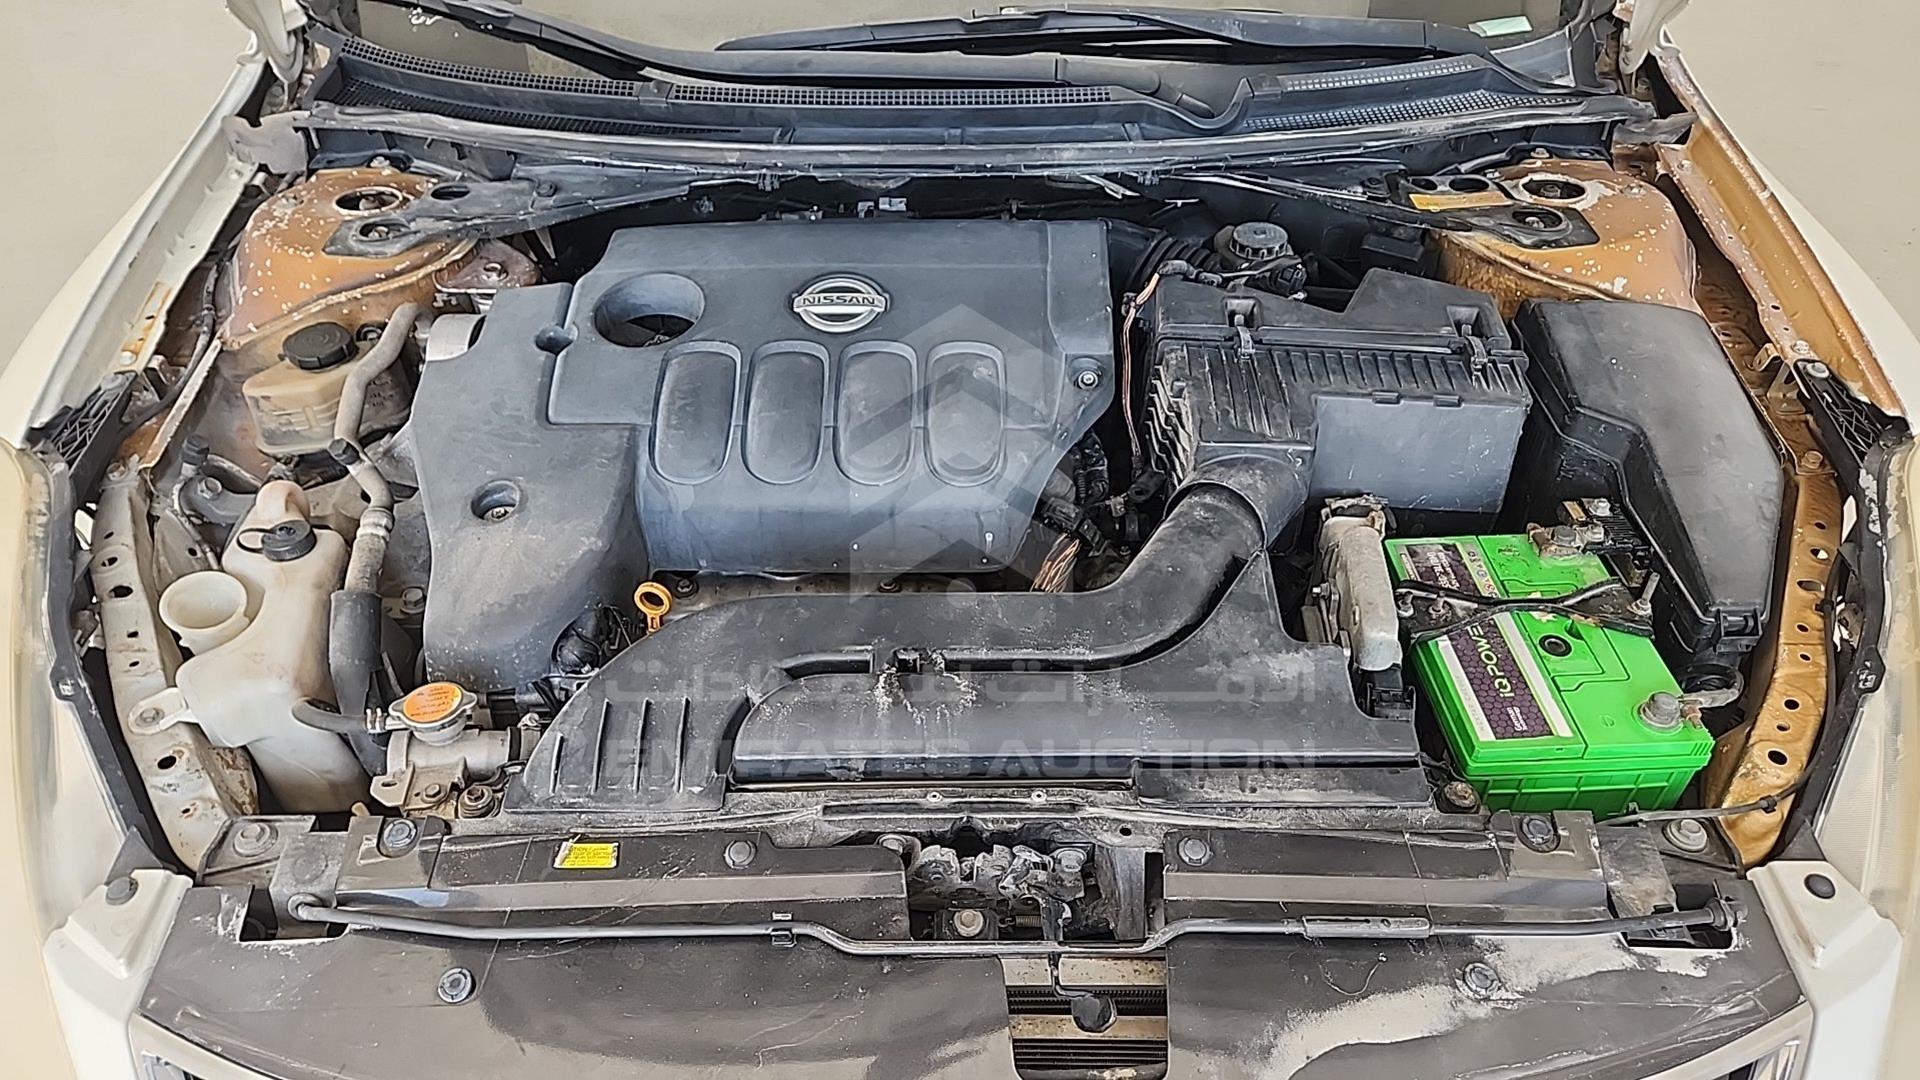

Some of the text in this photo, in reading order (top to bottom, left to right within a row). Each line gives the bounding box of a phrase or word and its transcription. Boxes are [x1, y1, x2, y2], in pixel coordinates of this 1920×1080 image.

[802, 295, 876, 305] NISSAN
[1466, 622, 1514, 698] iQPOWE
[1506, 706, 1524, 731] German
